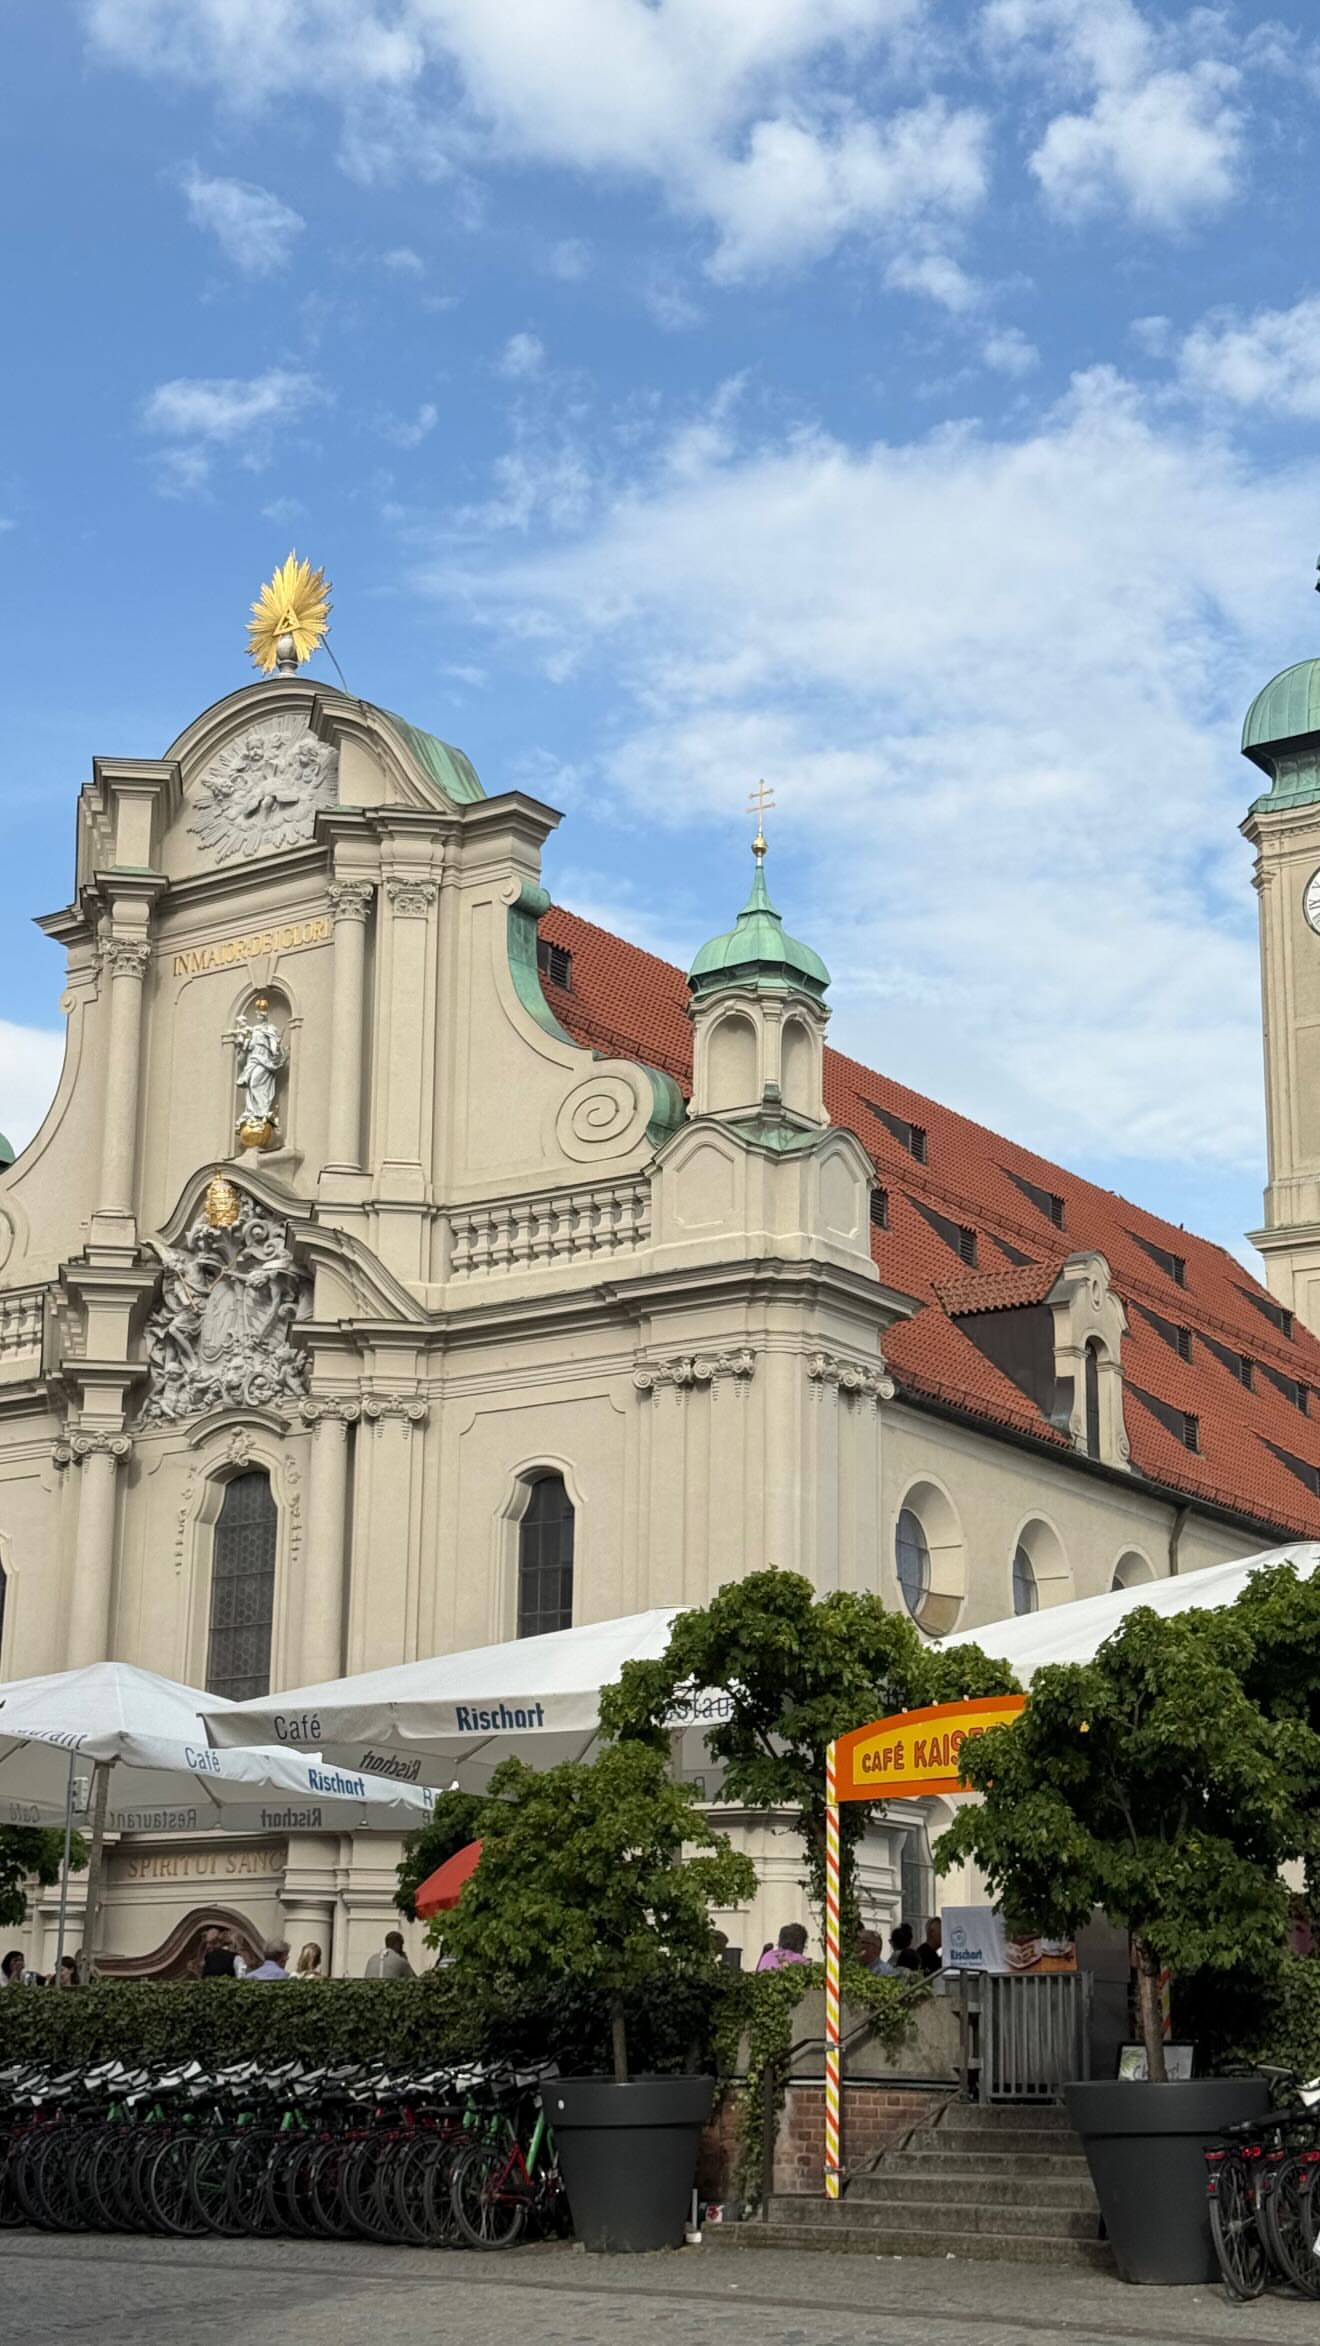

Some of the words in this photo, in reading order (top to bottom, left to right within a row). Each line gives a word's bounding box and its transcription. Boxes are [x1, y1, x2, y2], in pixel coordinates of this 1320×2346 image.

[274, 1713, 321, 1740] Café
[455, 1702, 544, 1731] Rischart
[184, 1746, 221, 1773] Café
[308, 1768, 365, 1796] Rischart
[862, 1740, 905, 1773] CAFÉ
[226, 1850, 287, 1874] SANC
